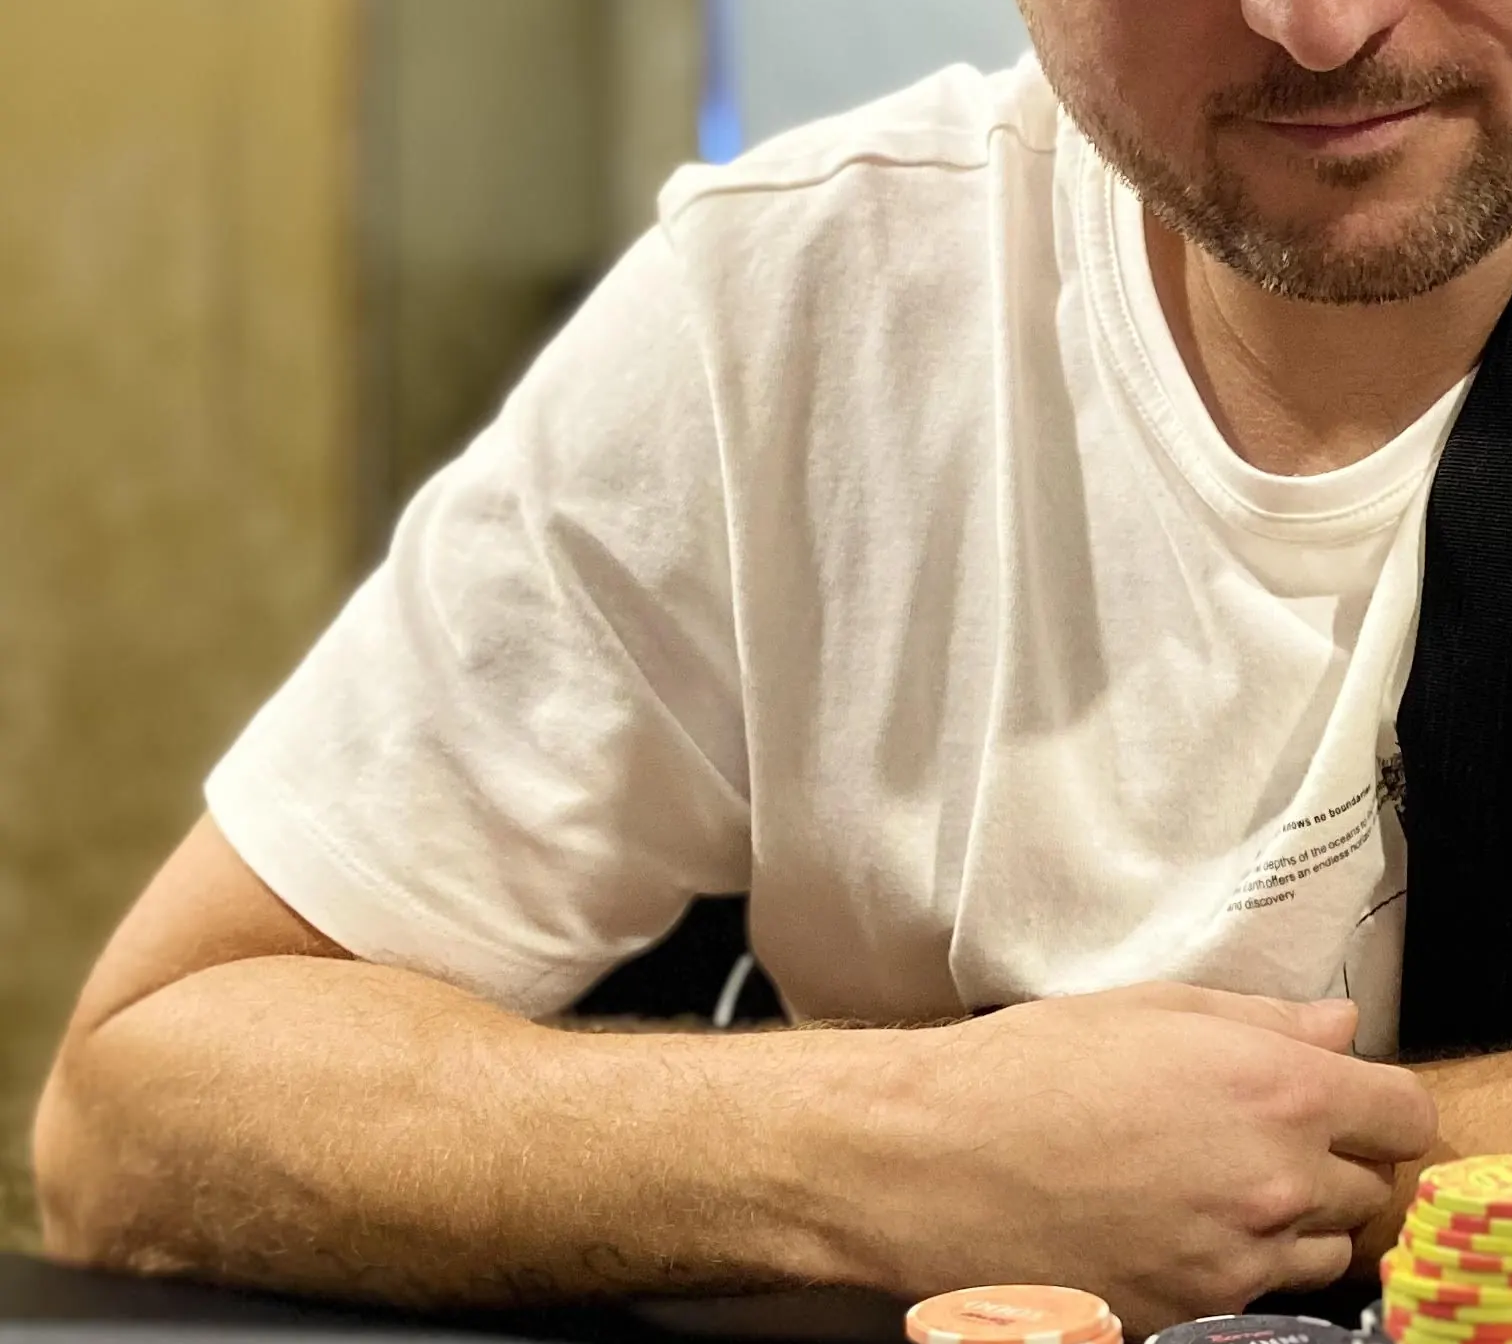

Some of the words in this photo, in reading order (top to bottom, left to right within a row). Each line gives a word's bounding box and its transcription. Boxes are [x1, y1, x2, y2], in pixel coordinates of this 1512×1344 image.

[1314, 813, 1327, 824] no
[1263, 855, 1297, 874] depths
[1298, 851, 1309, 865] of
[1310, 844, 1327, 859] the
[1328, 828, 1361, 850] oceans
[1297, 868, 1311, 879] an
[1312, 849, 1350, 873] endless
[1244, 889, 1296, 911] discovery
